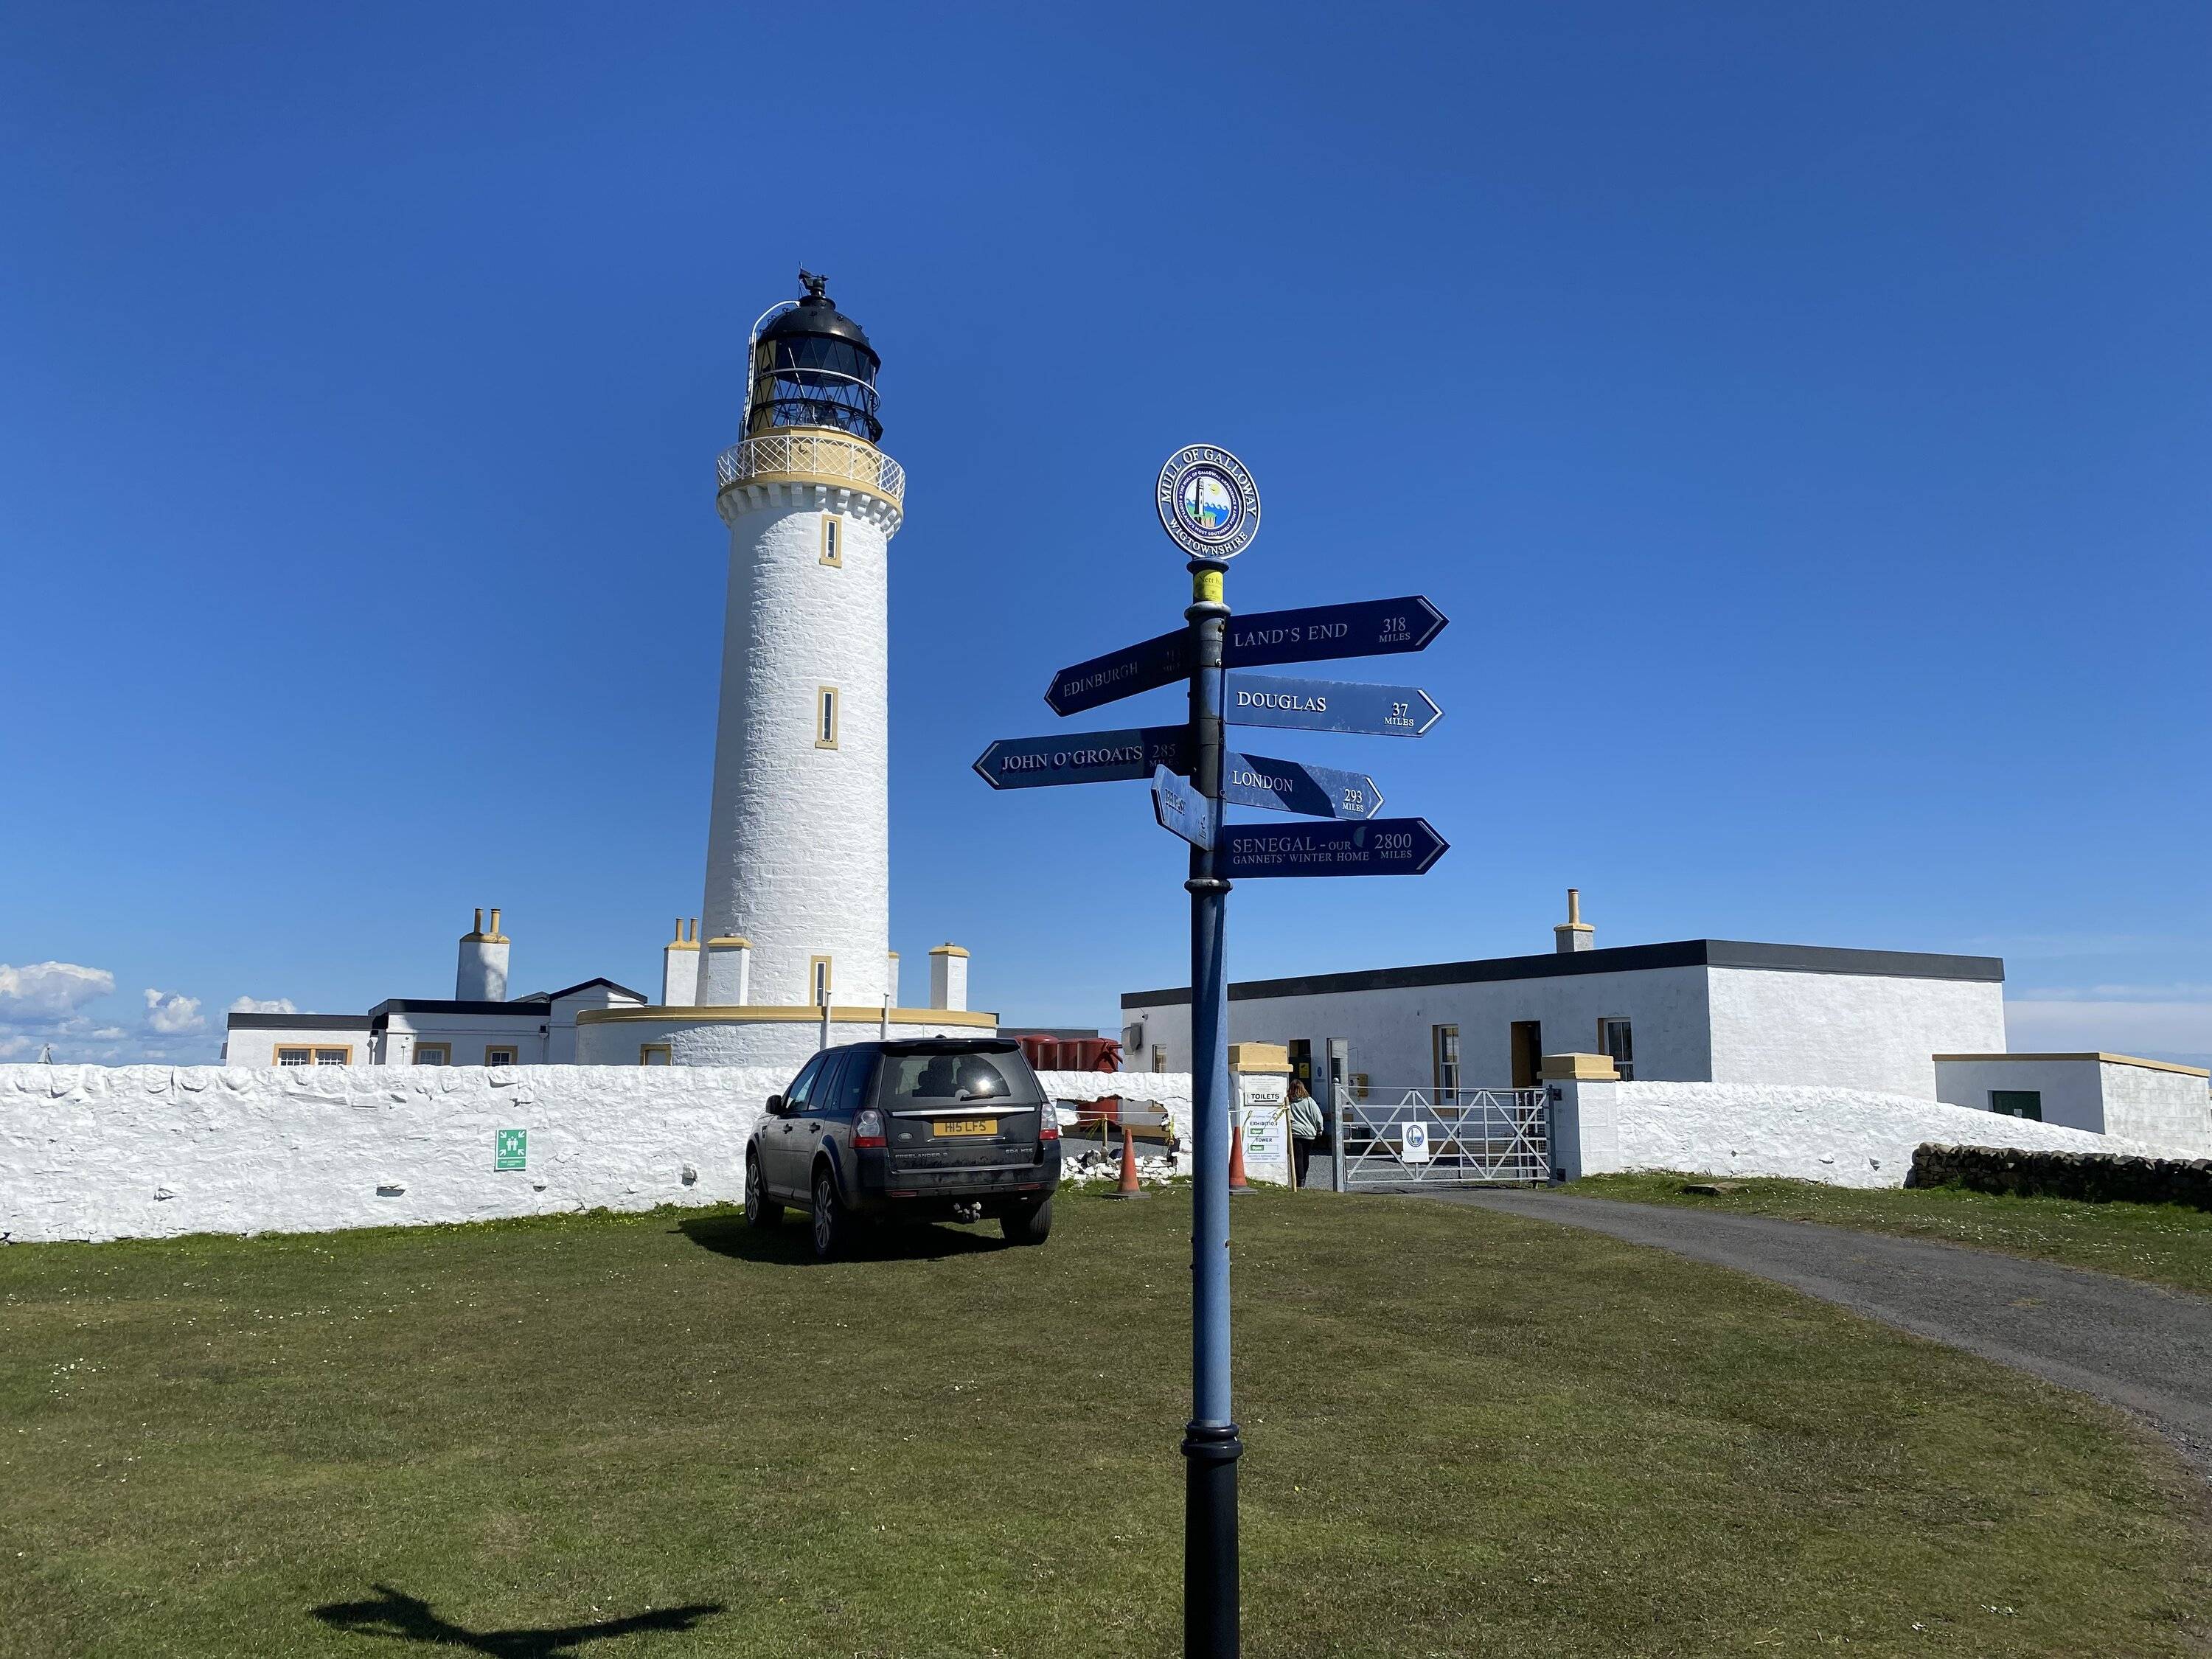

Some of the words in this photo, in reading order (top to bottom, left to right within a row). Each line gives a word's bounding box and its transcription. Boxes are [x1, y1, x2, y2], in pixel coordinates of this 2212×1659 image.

[1161, 462, 1182, 504] MULL
[1183, 449, 1200, 463] OF
[1204, 448, 1256, 518] GALLOWAY
[1169, 518, 1248, 555] WIGTOWNSHIRE
[1194, 526, 1207, 535] MOST
[1208, 523, 1231, 536] SOUTHERLY
[1383, 616, 1406, 633] 318
[1234, 627, 1300, 647] LAND'S
[1308, 623, 1348, 641] END
[1379, 632, 1411, 643] MILES
[1063, 661, 1139, 698] EDINBURGH
[1237, 691, 1326, 713] DOUGLAS
[1392, 702, 1408, 717] 37
[1384, 717, 1414, 727] MILES
[1002, 753, 1048, 771] JOHN
[1054, 745, 1143, 766] O'GROATS
[1152, 743, 1176, 758] 285
[1232, 770, 1293, 793] LONDON
[1344, 788, 1363, 804] 293
[1342, 802, 1364, 813] MILES
[1233, 836, 1316, 855] SENEGAL
[1329, 841, 1352, 851] OUR
[1374, 833, 1413, 849] 2800
[1233, 854, 1286, 865] GANNETS'
[1290, 853, 1332, 863] WINTER
[1337, 852, 1369, 862] HOME
[1380, 850, 1412, 859] MILES
[965, 1120, 986, 1132] LFS
